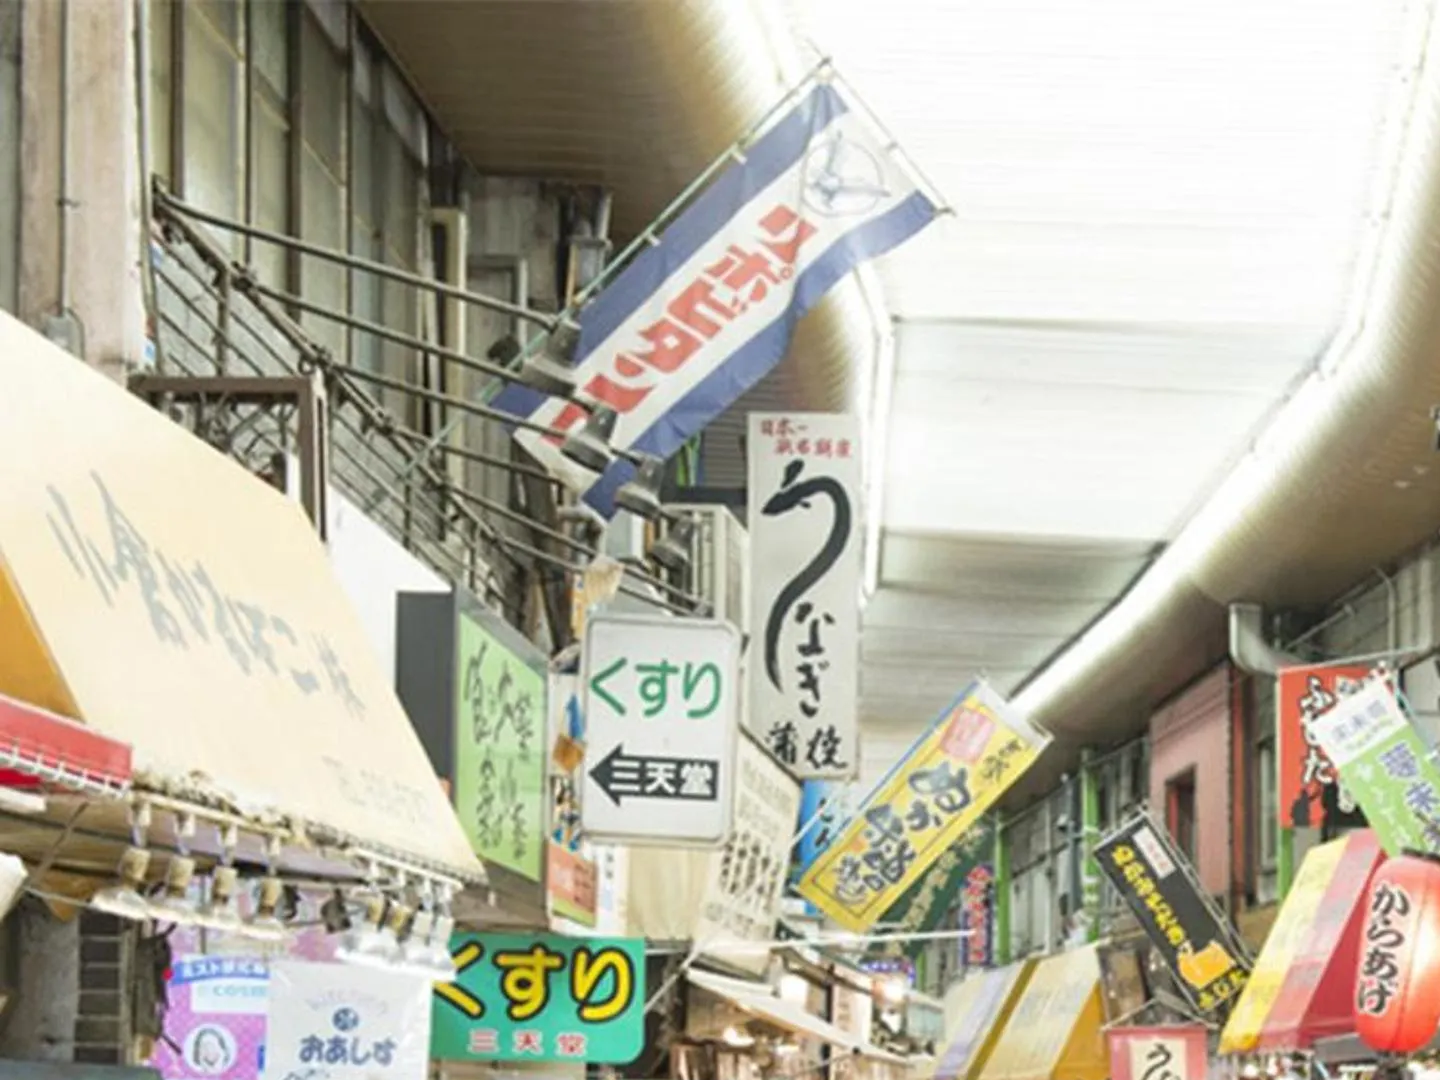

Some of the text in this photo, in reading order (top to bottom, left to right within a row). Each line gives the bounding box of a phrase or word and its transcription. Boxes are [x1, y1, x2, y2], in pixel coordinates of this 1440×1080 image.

[589, 656, 723, 719] くすり
[609, 754, 716, 798] 三天堂
[1356, 885, 1412, 1016] からあげ
[431, 940, 635, 1023] くすり
[299, 1034, 397, 1066] おあしす
[467, 1027, 588, 1057] 三天堂
